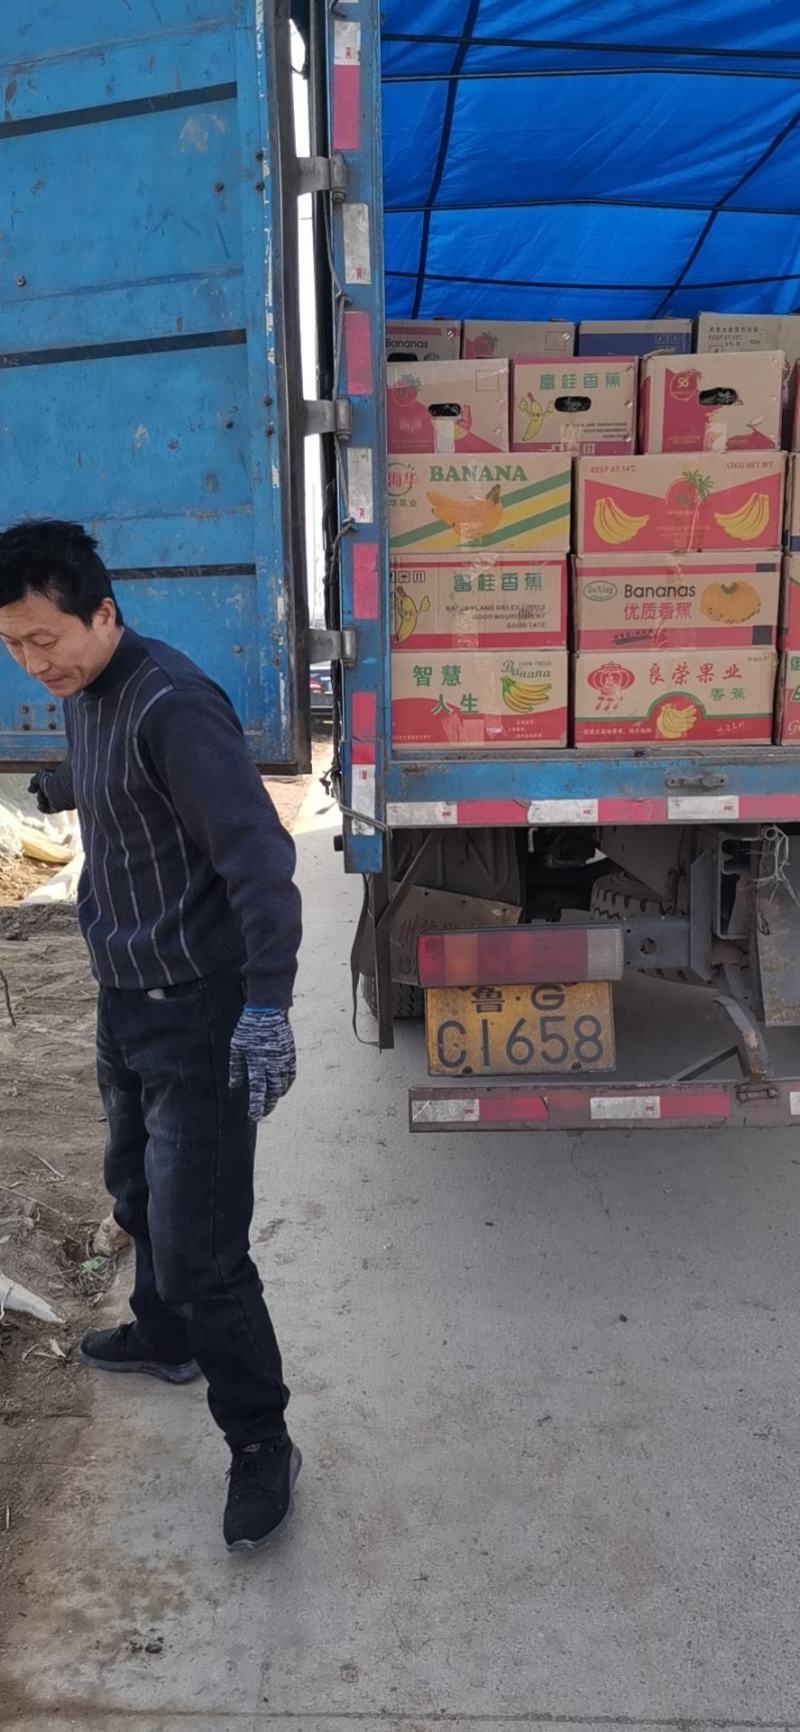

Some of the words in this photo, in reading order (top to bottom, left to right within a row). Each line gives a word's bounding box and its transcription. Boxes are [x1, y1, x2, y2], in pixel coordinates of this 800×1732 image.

[386, 338, 428, 349] Bananas
[429, 465, 528, 482] BANANA
[624, 584, 696, 598] Bananas
[624, 602, 692, 620] 优质香蕉
[413, 665, 463, 687] 智慧
[500, 659, 551, 678] Banana
[649, 662, 742, 685] 良荣果业
[710, 687, 746, 701] 香蕉
[432, 693, 480, 715] 人生
[437, 1015, 604, 1068] C1658
